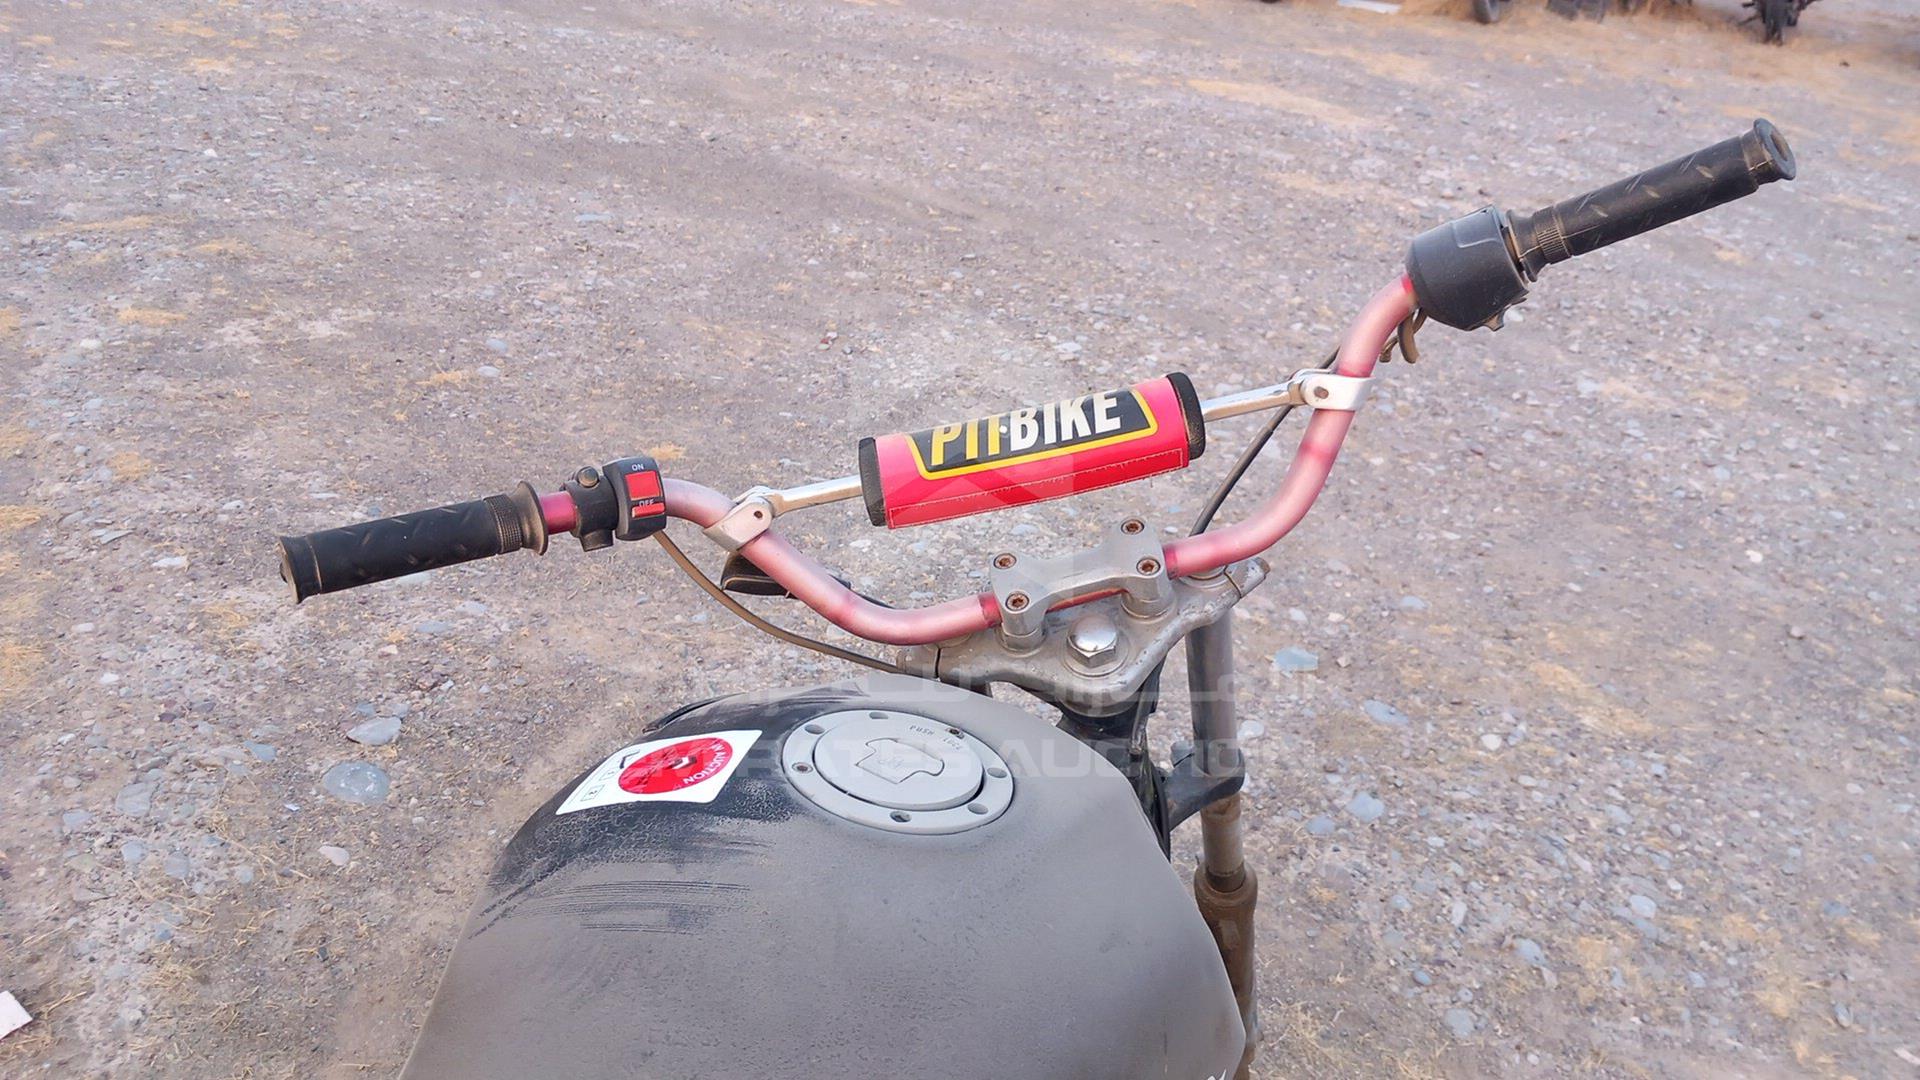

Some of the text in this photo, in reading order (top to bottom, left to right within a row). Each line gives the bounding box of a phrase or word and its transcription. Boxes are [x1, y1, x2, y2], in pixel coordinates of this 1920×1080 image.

[632, 463, 645, 471] ON
[639, 499, 655, 507] OFF
[683, 750, 727, 784] AUCTION
